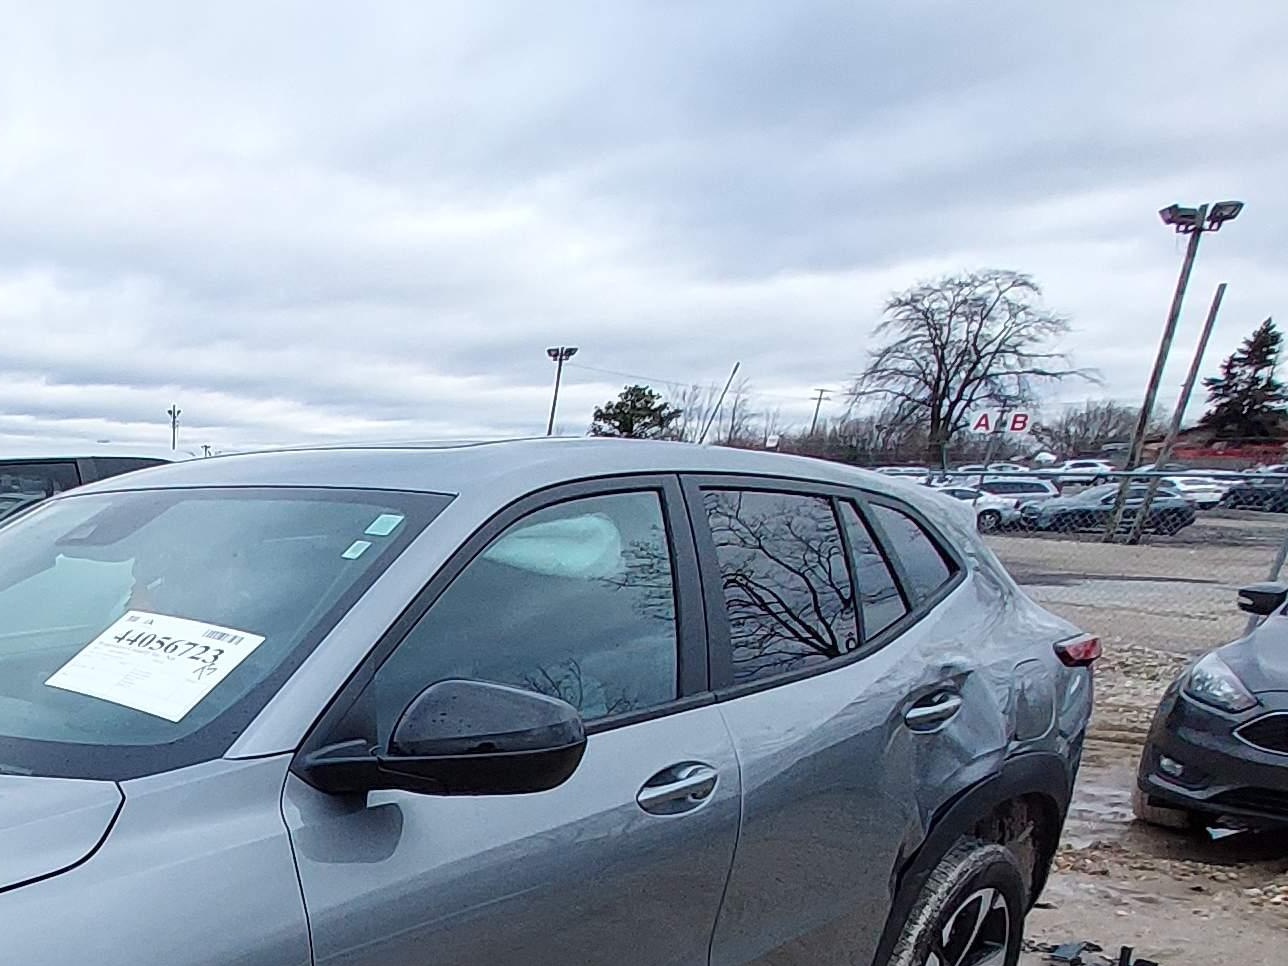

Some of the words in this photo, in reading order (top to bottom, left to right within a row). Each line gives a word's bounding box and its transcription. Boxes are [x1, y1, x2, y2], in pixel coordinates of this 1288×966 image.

[973, 413, 990, 431] A
[1010, 413, 1029, 431] B
[114, 629, 225, 664] 44056723
